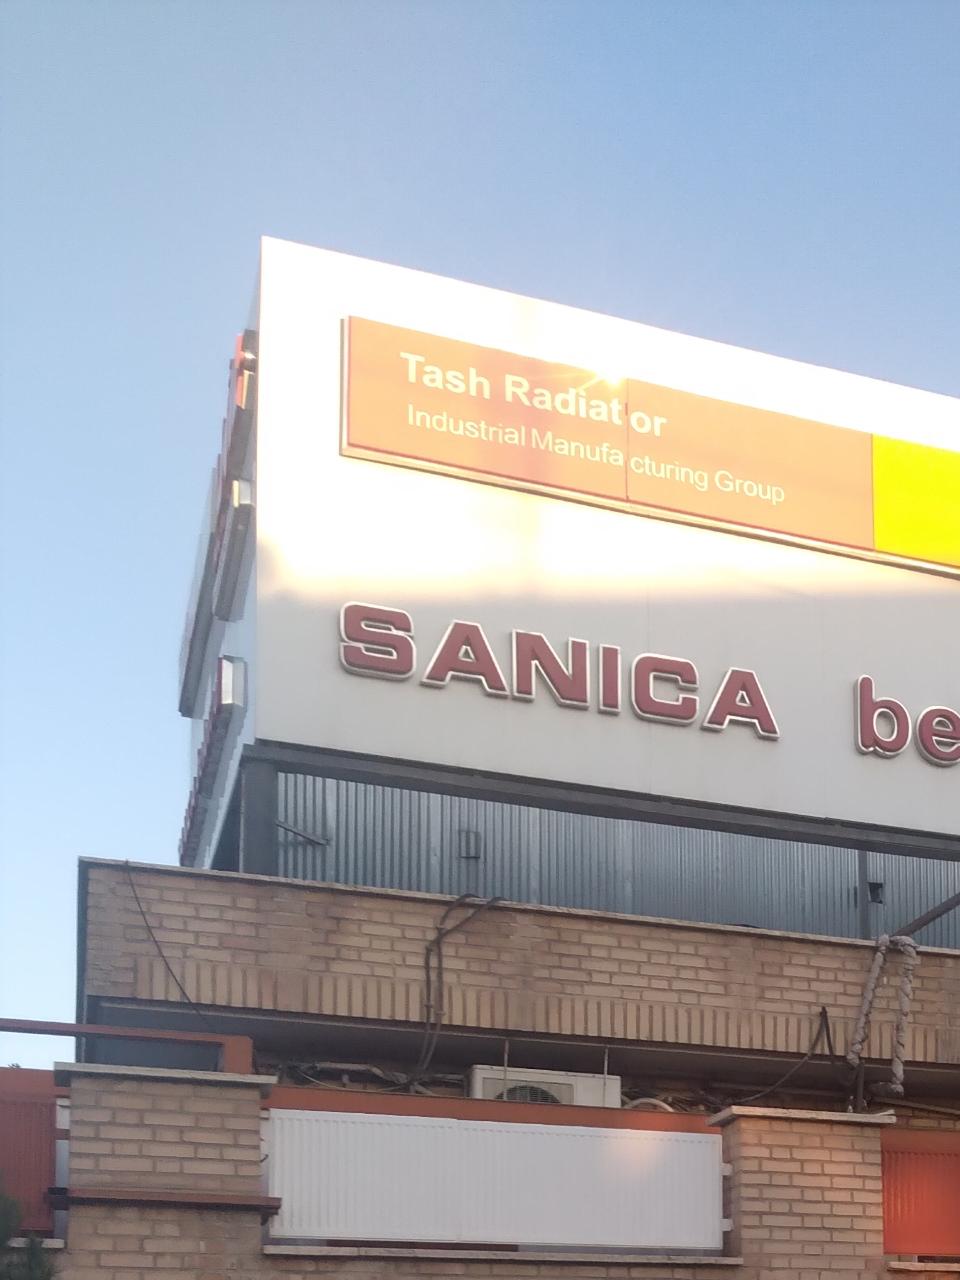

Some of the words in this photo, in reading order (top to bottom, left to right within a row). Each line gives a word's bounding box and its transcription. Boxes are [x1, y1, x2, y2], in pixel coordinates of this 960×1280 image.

[400, 351, 491, 400] Tash
[504, 374, 668, 437] Radiator
[407, 403, 526, 446] Industrial
[530, 430, 709, 492] Manufacturing
[714, 469, 786, 506] Group
[339, 600, 781, 741] SANICA
